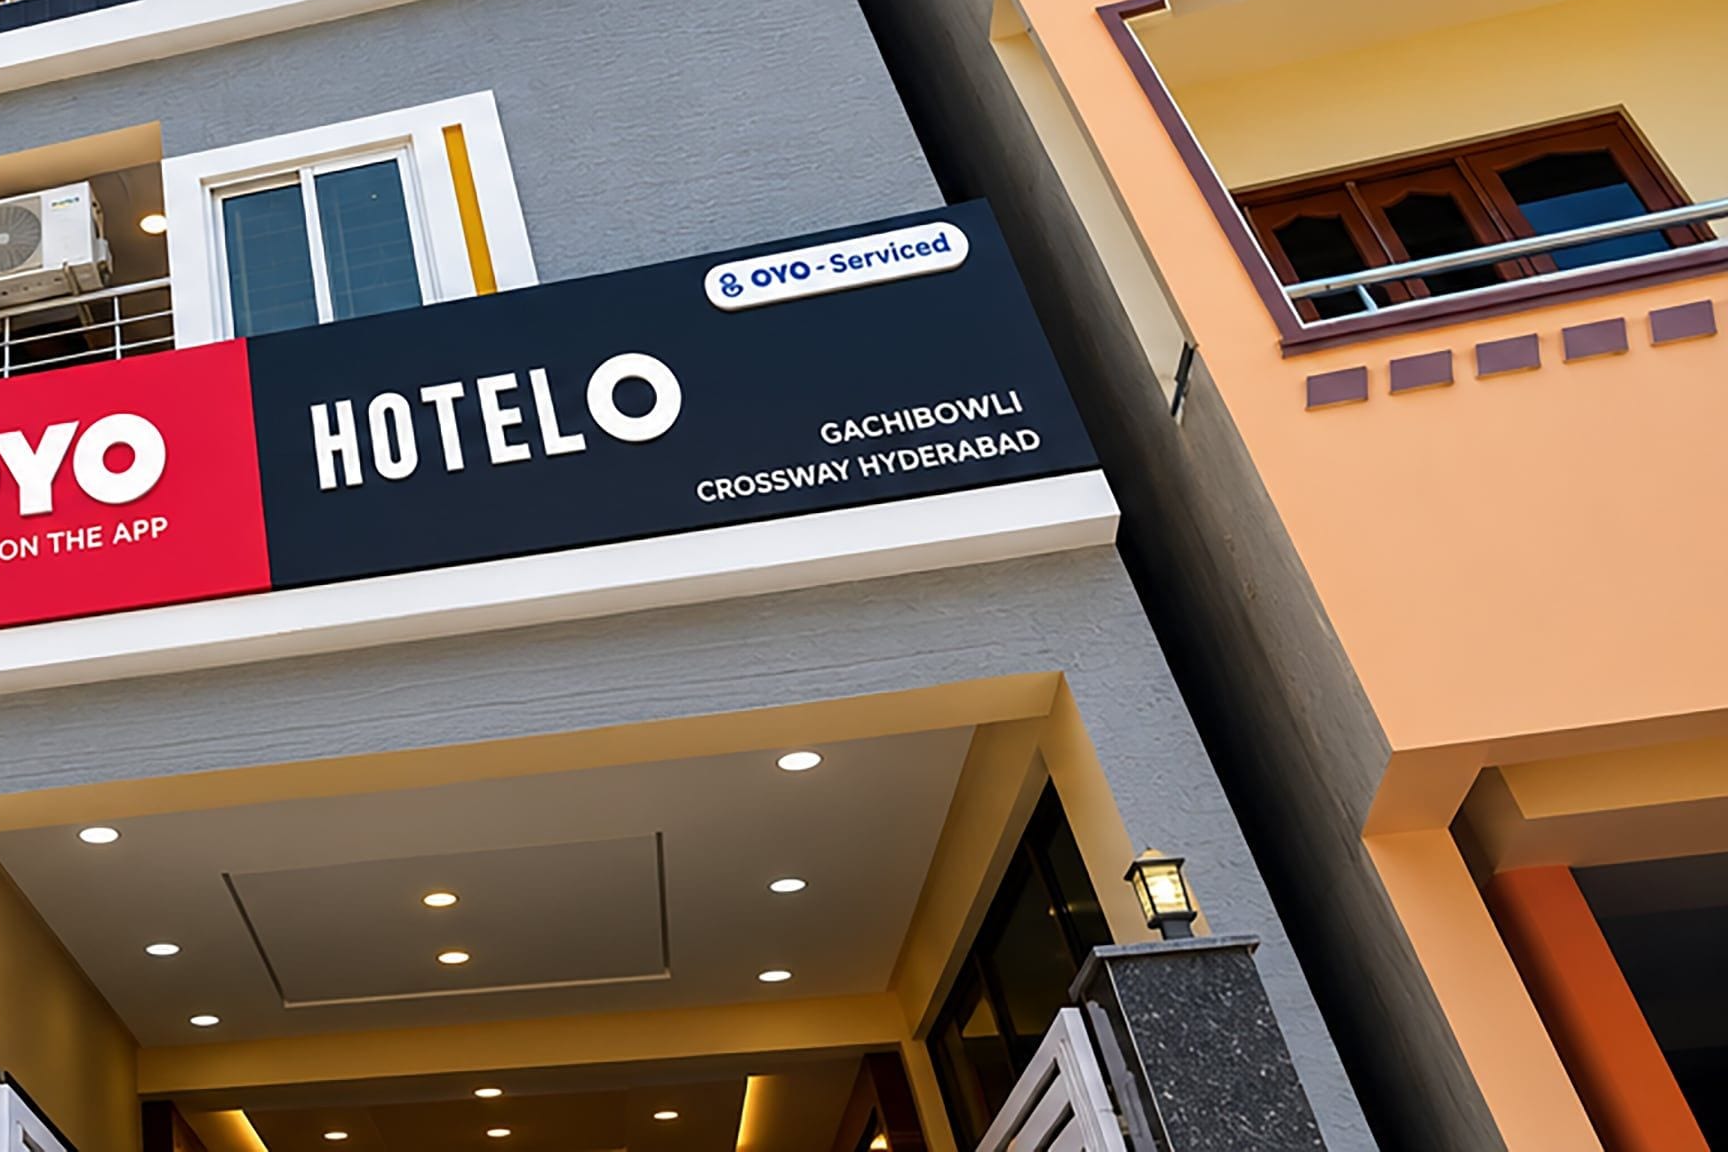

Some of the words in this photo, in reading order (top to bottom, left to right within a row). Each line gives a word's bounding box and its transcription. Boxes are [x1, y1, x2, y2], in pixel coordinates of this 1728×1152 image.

[820, 390, 1023, 444] GACHIBOWLI
[696, 458, 850, 502] CROSSWAY
[857, 429, 1041, 477] HYDERABAD
[46, 525, 103, 554] THE
[112, 516, 168, 545] APP
